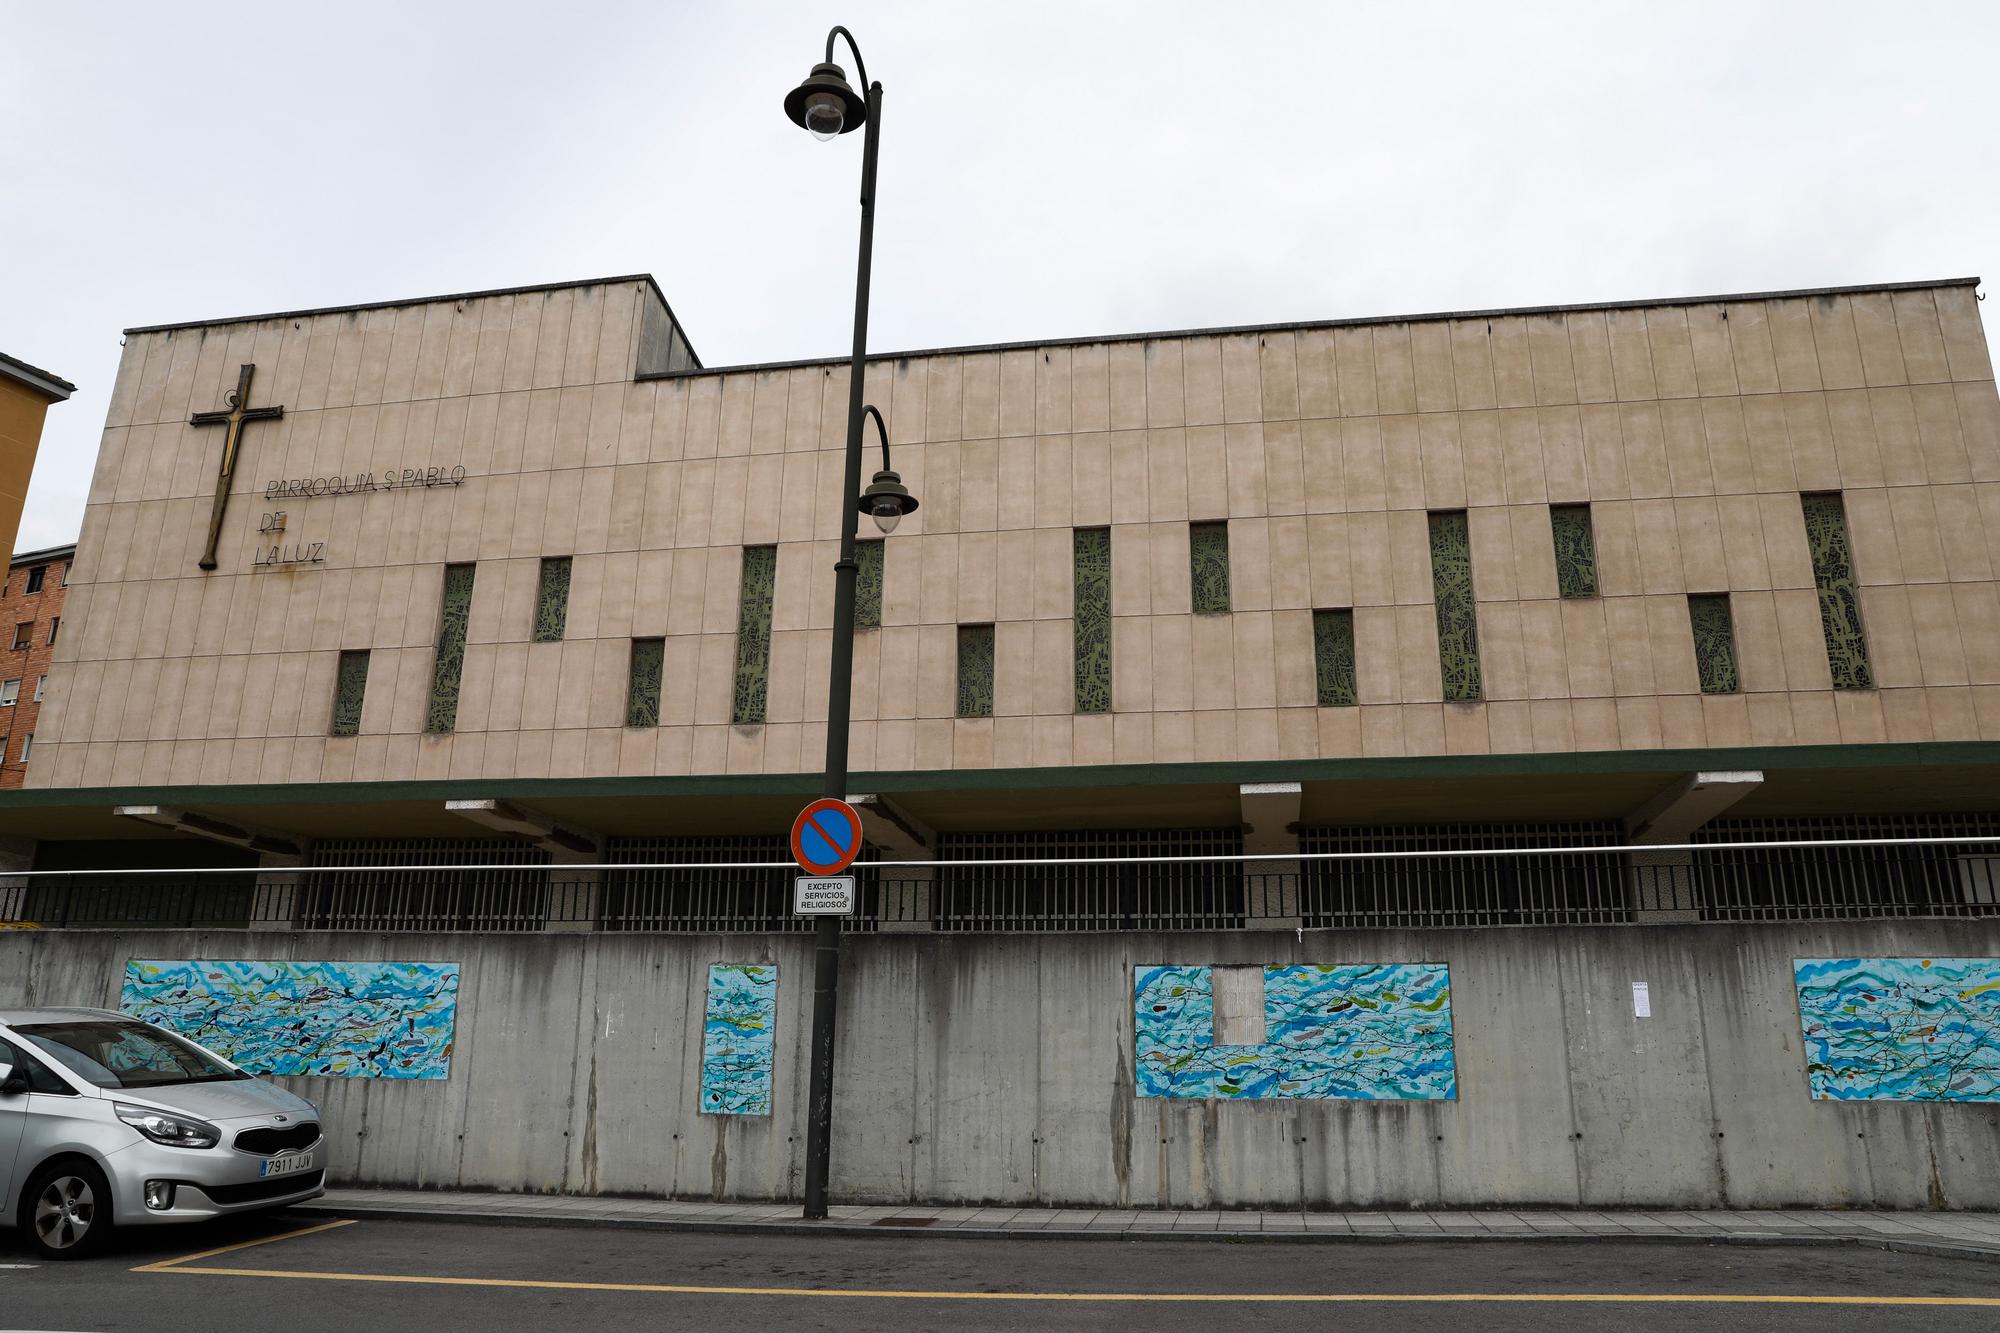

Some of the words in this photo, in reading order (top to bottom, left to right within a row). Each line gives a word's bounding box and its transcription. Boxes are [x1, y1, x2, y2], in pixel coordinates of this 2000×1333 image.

[265, 472, 376, 499] PARROQUIA
[383, 470, 395, 489] S
[402, 464, 466, 487] PABLO
[260, 511, 287, 531] DE
[807, 882, 843, 890] EXCEPTO
[804, 891, 845, 899] SERVICIOS
[801, 900, 847, 908] RELIGIOSOS
[268, 1158, 292, 1174] 7911
